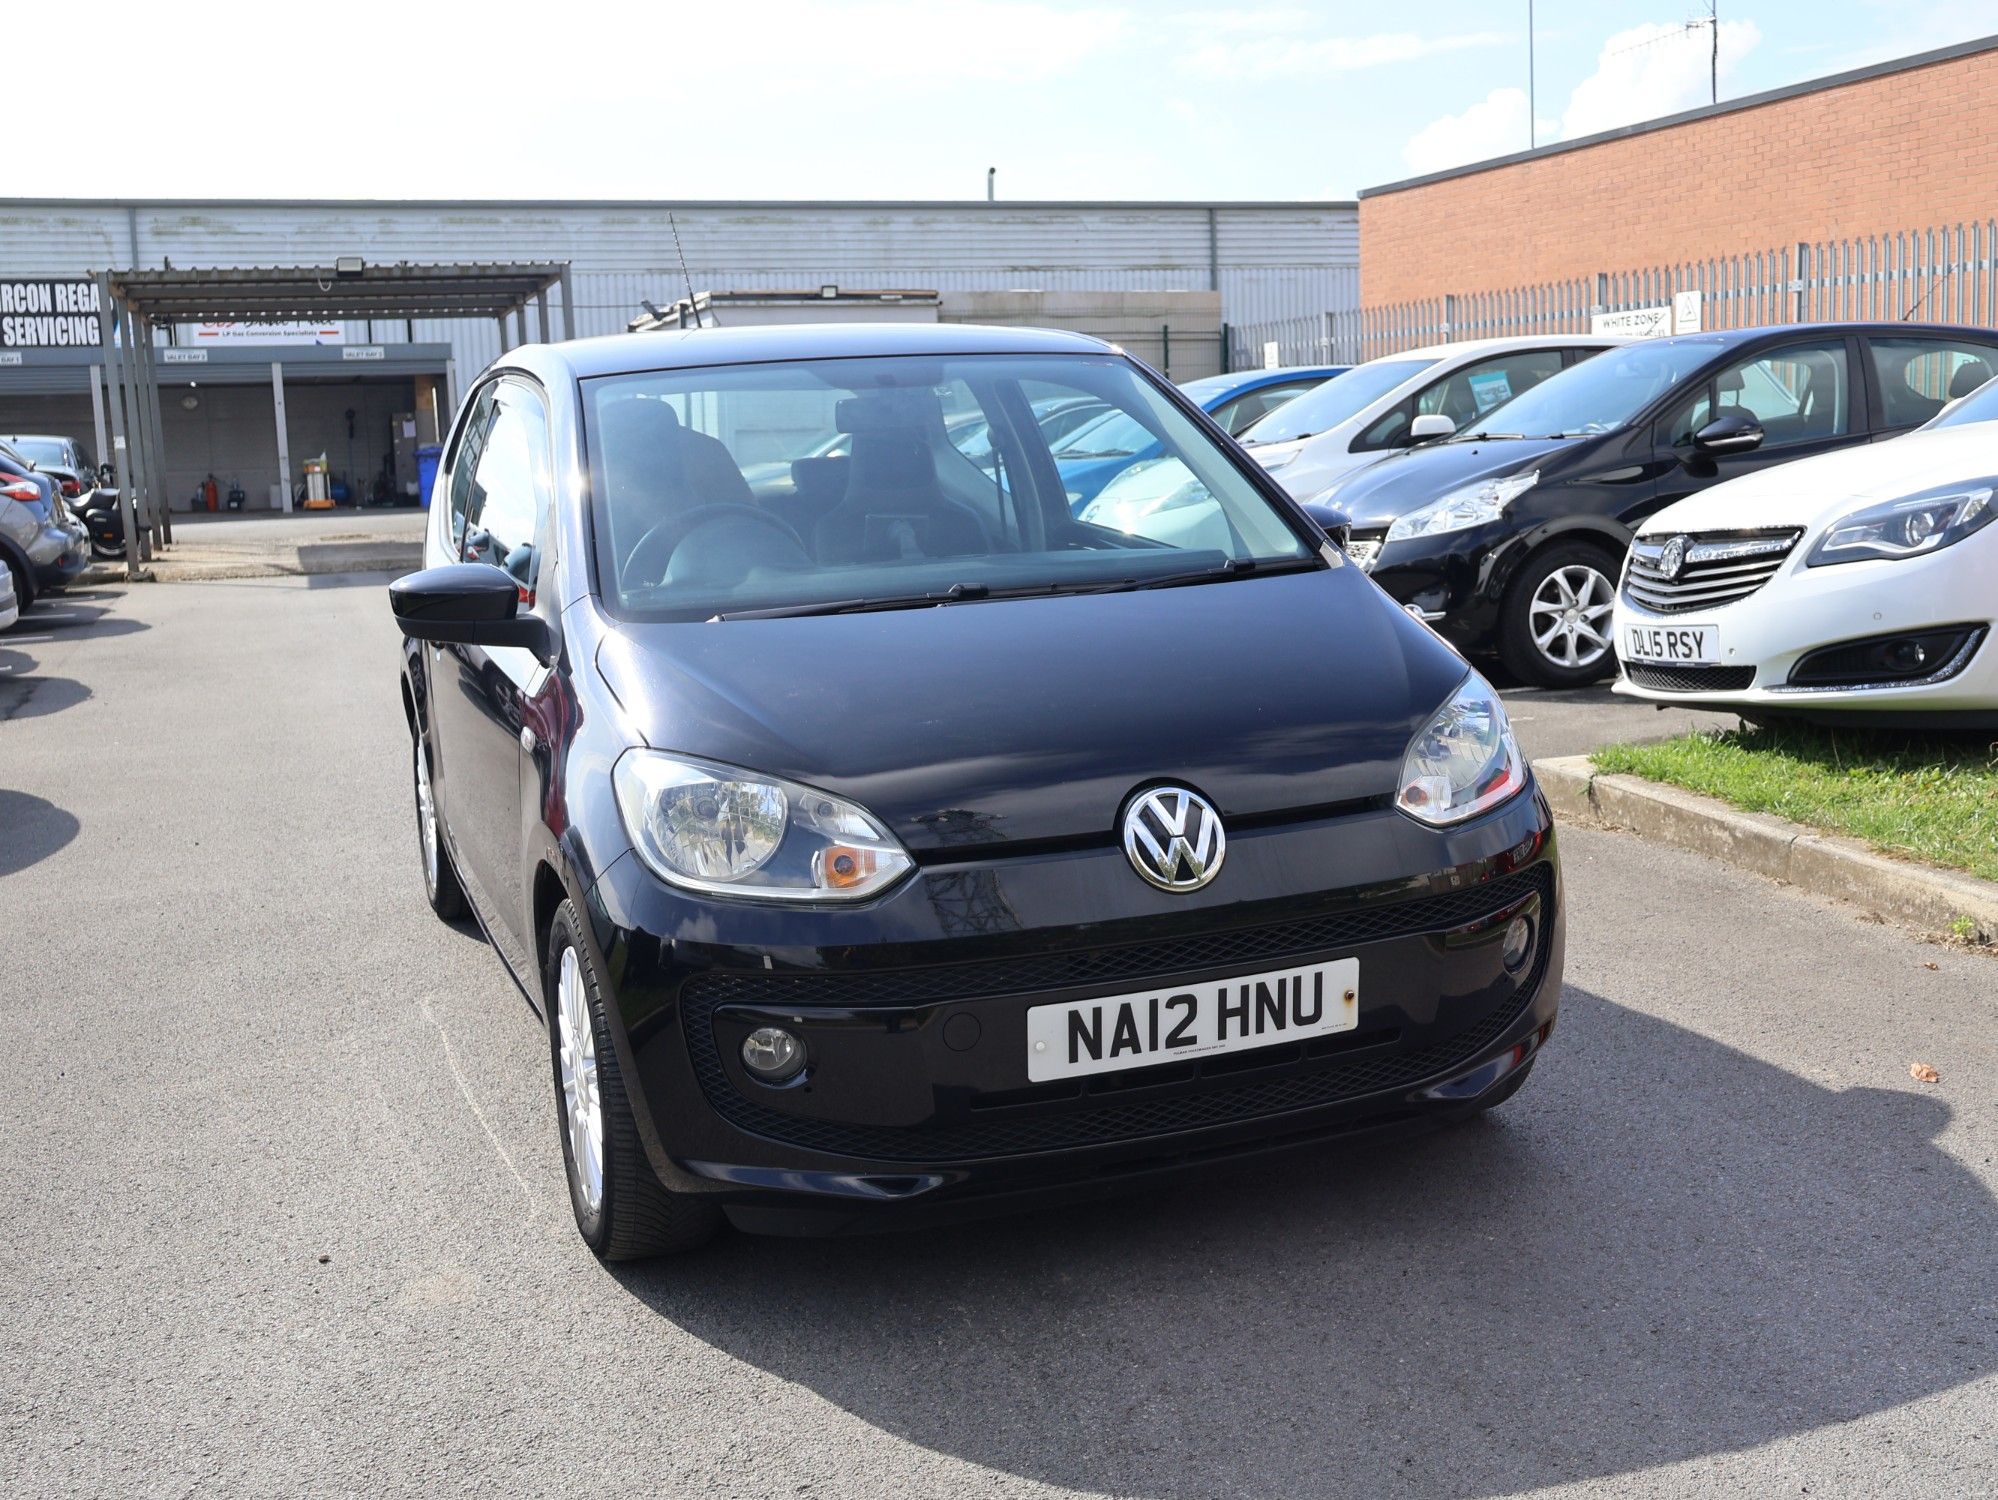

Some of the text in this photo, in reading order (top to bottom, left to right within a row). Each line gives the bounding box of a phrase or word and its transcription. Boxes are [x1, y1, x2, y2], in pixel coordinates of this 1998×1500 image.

[0, 283, 113, 313] RCON REGA
[2, 316, 100, 346] SERVICING
[1603, 313, 1660, 328] WHITE ZONE
[1632, 629, 1704, 658] DL15 RSY
[1068, 971, 1323, 1064] NA12 HNU
